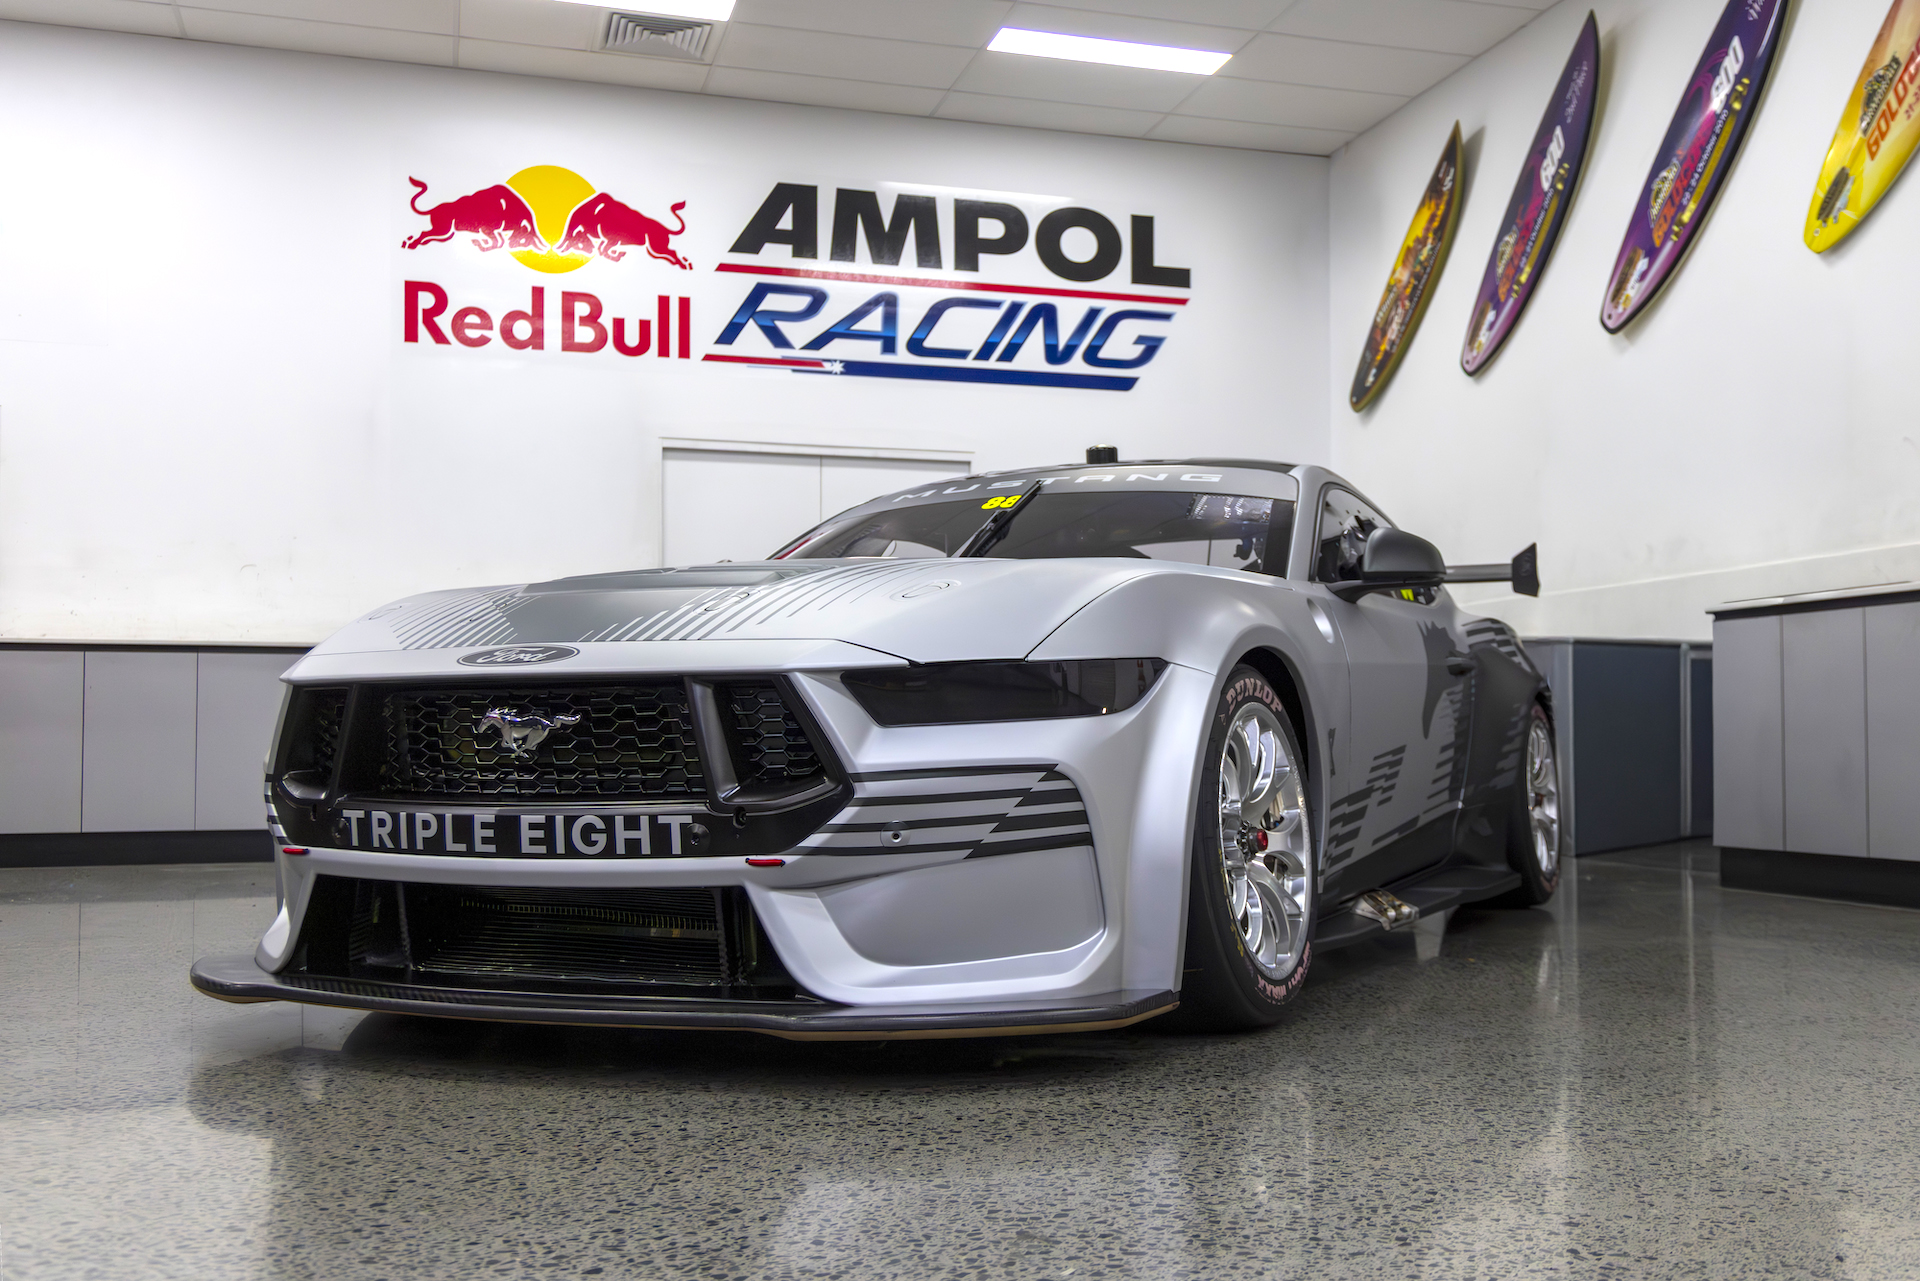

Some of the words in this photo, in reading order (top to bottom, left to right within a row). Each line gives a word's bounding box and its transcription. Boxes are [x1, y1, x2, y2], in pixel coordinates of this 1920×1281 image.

[1540, 125, 1565, 192] 600
[729, 182, 1190, 289] AMPOL
[404, 279, 544, 351] Red
[562, 291, 690, 360] Bull
[713, 282, 1177, 370] RACING
[892, 473, 1224, 503] MUSTANG
[981, 494, 1022, 510] 88
[476, 646, 558, 663] Ford
[1225, 677, 1284, 716] DUNLOP
[342, 809, 498, 853] TRIPLE
[519, 814, 694, 855] EIGHT
